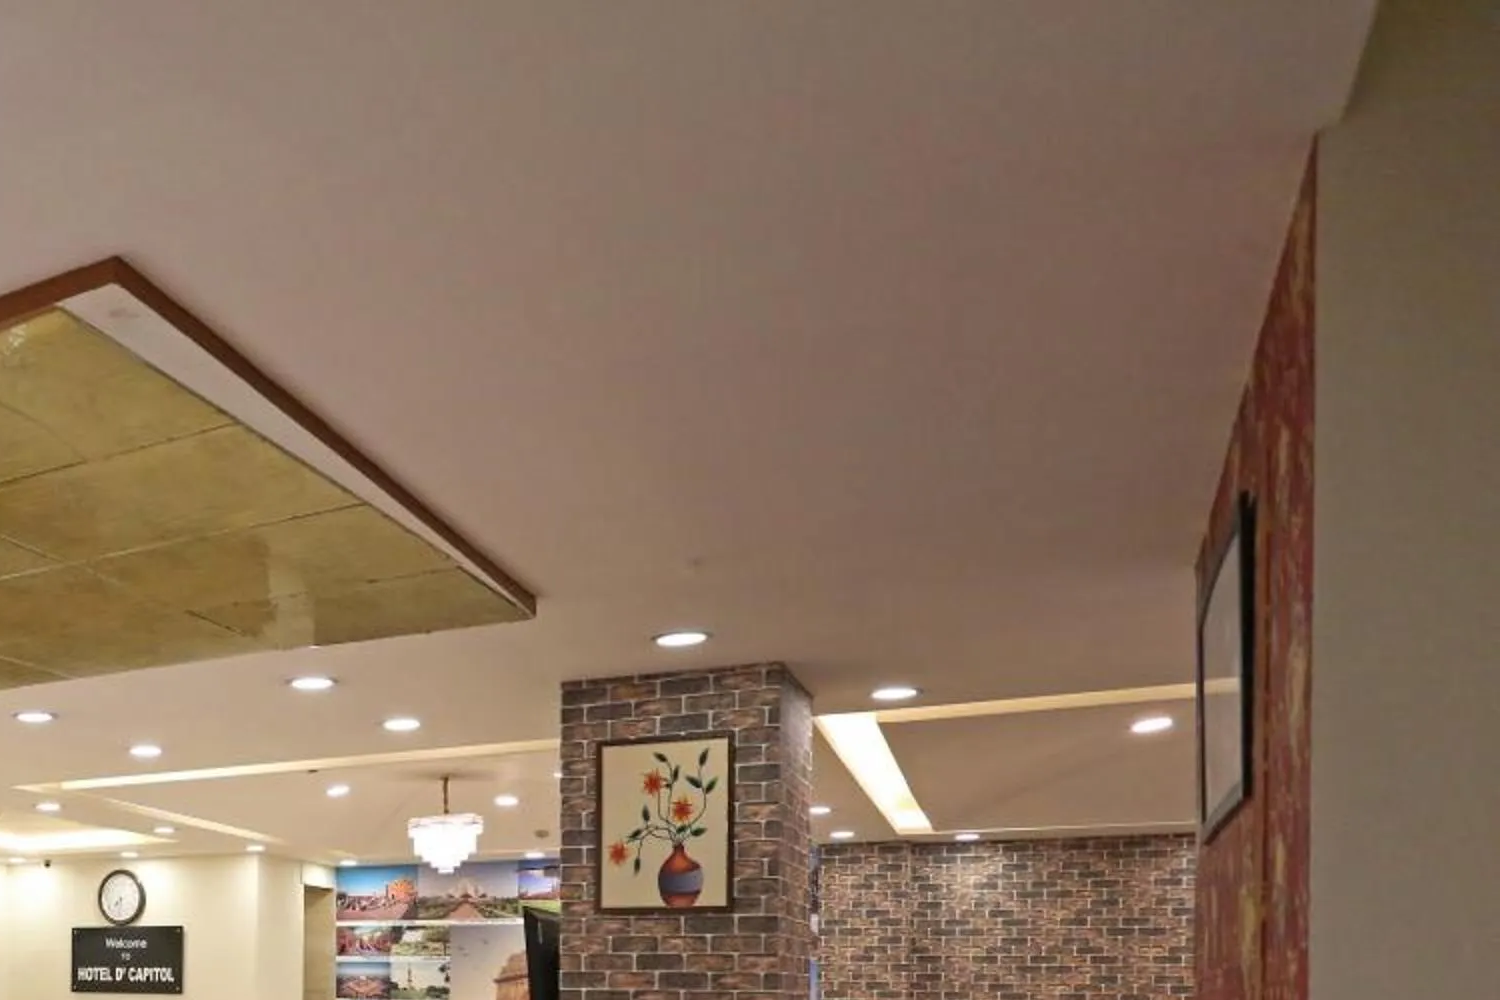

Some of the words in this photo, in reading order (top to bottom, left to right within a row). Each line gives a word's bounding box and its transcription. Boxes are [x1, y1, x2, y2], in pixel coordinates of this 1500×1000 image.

[105, 938, 148, 949] Welcome
[77, 967, 113, 981] HOTEL
[127, 967, 175, 982] CAPITOL
